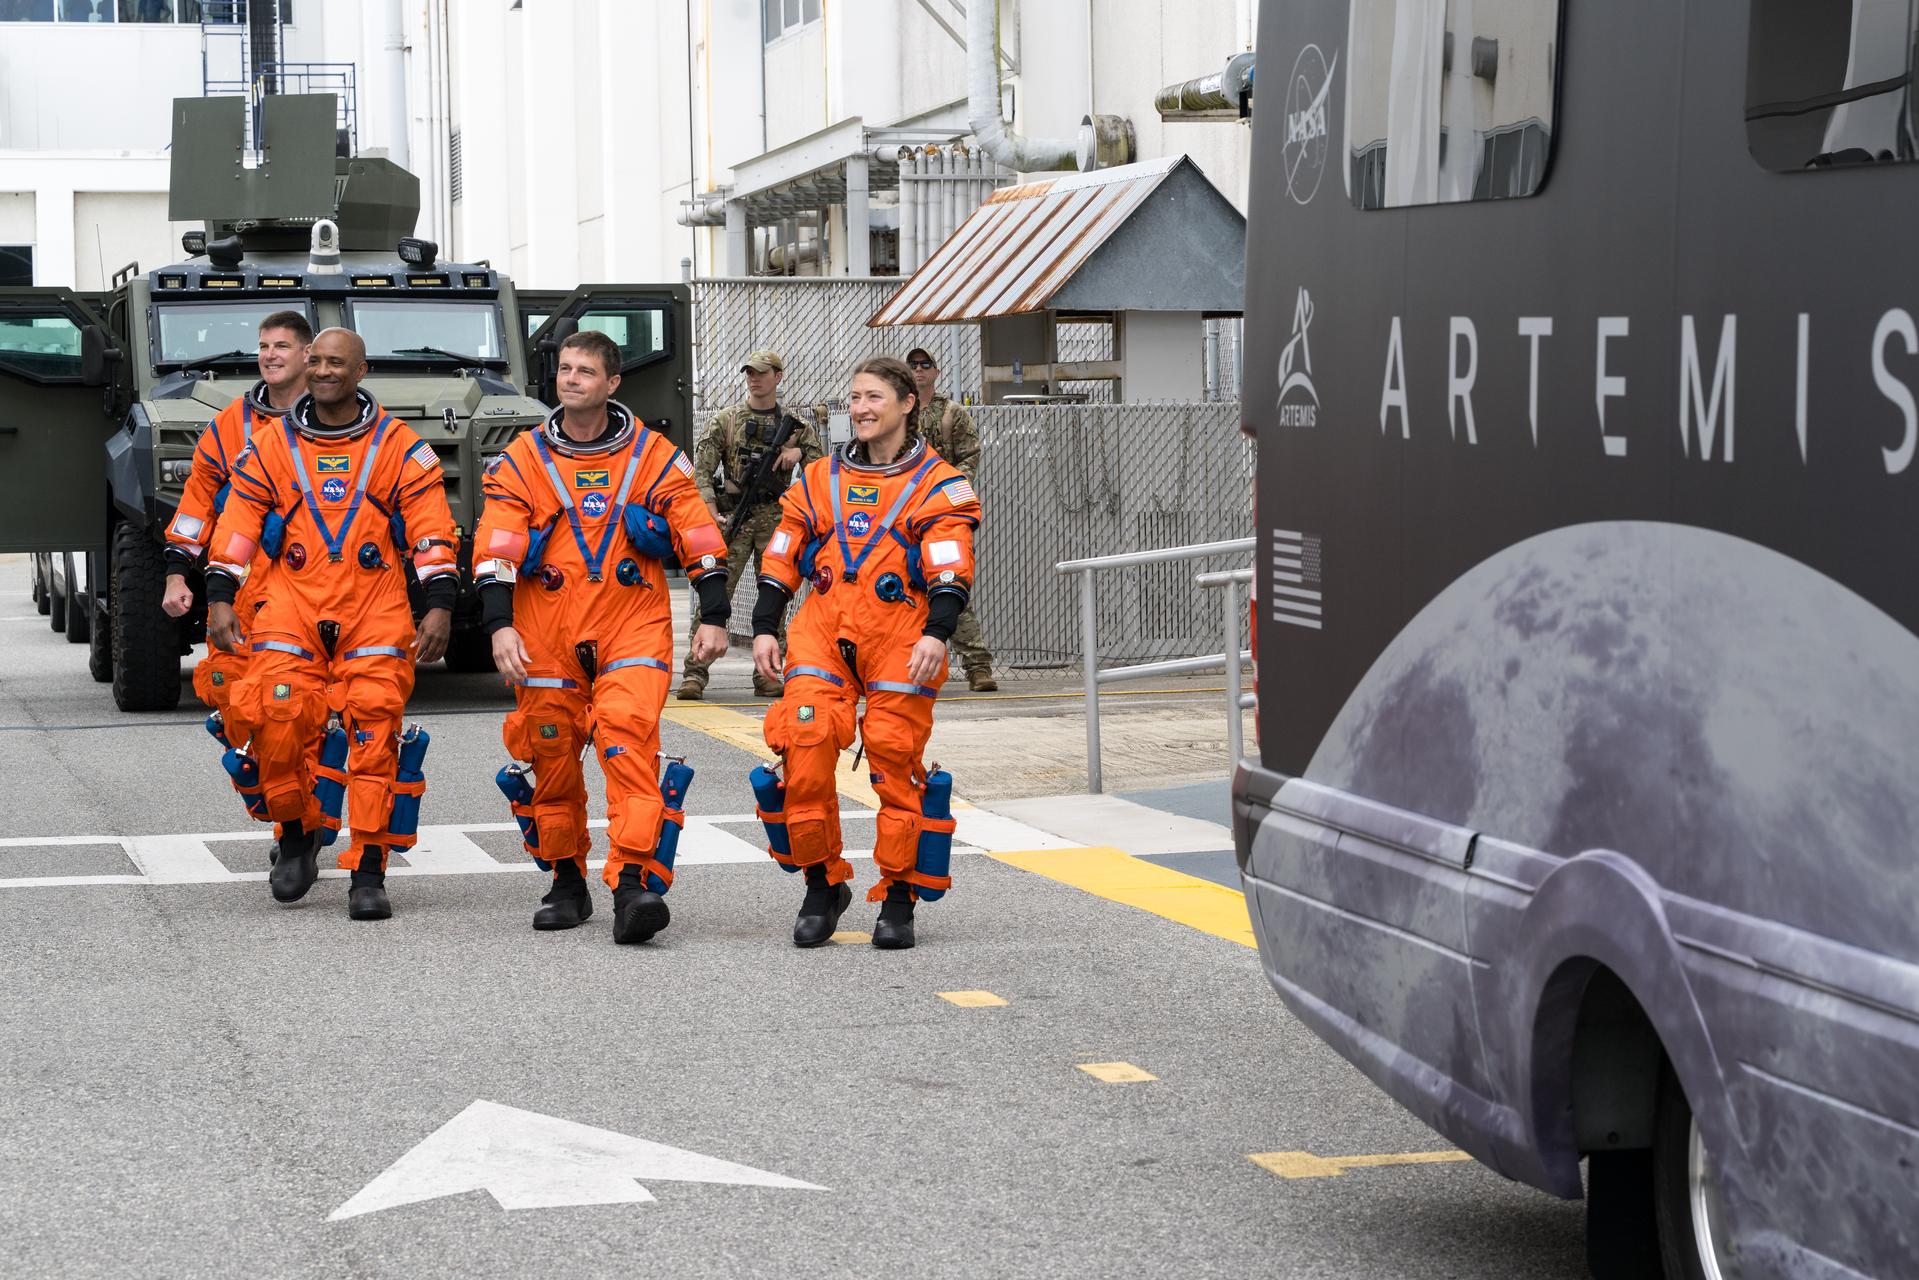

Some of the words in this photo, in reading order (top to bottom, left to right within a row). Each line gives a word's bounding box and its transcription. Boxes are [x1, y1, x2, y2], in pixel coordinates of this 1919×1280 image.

[1288, 104, 1326, 144] NASA
[1380, 308, 1919, 475] ARTEMIS
[1280, 404, 1316, 427] ARTEMIS
[849, 520, 869, 529] NASA
